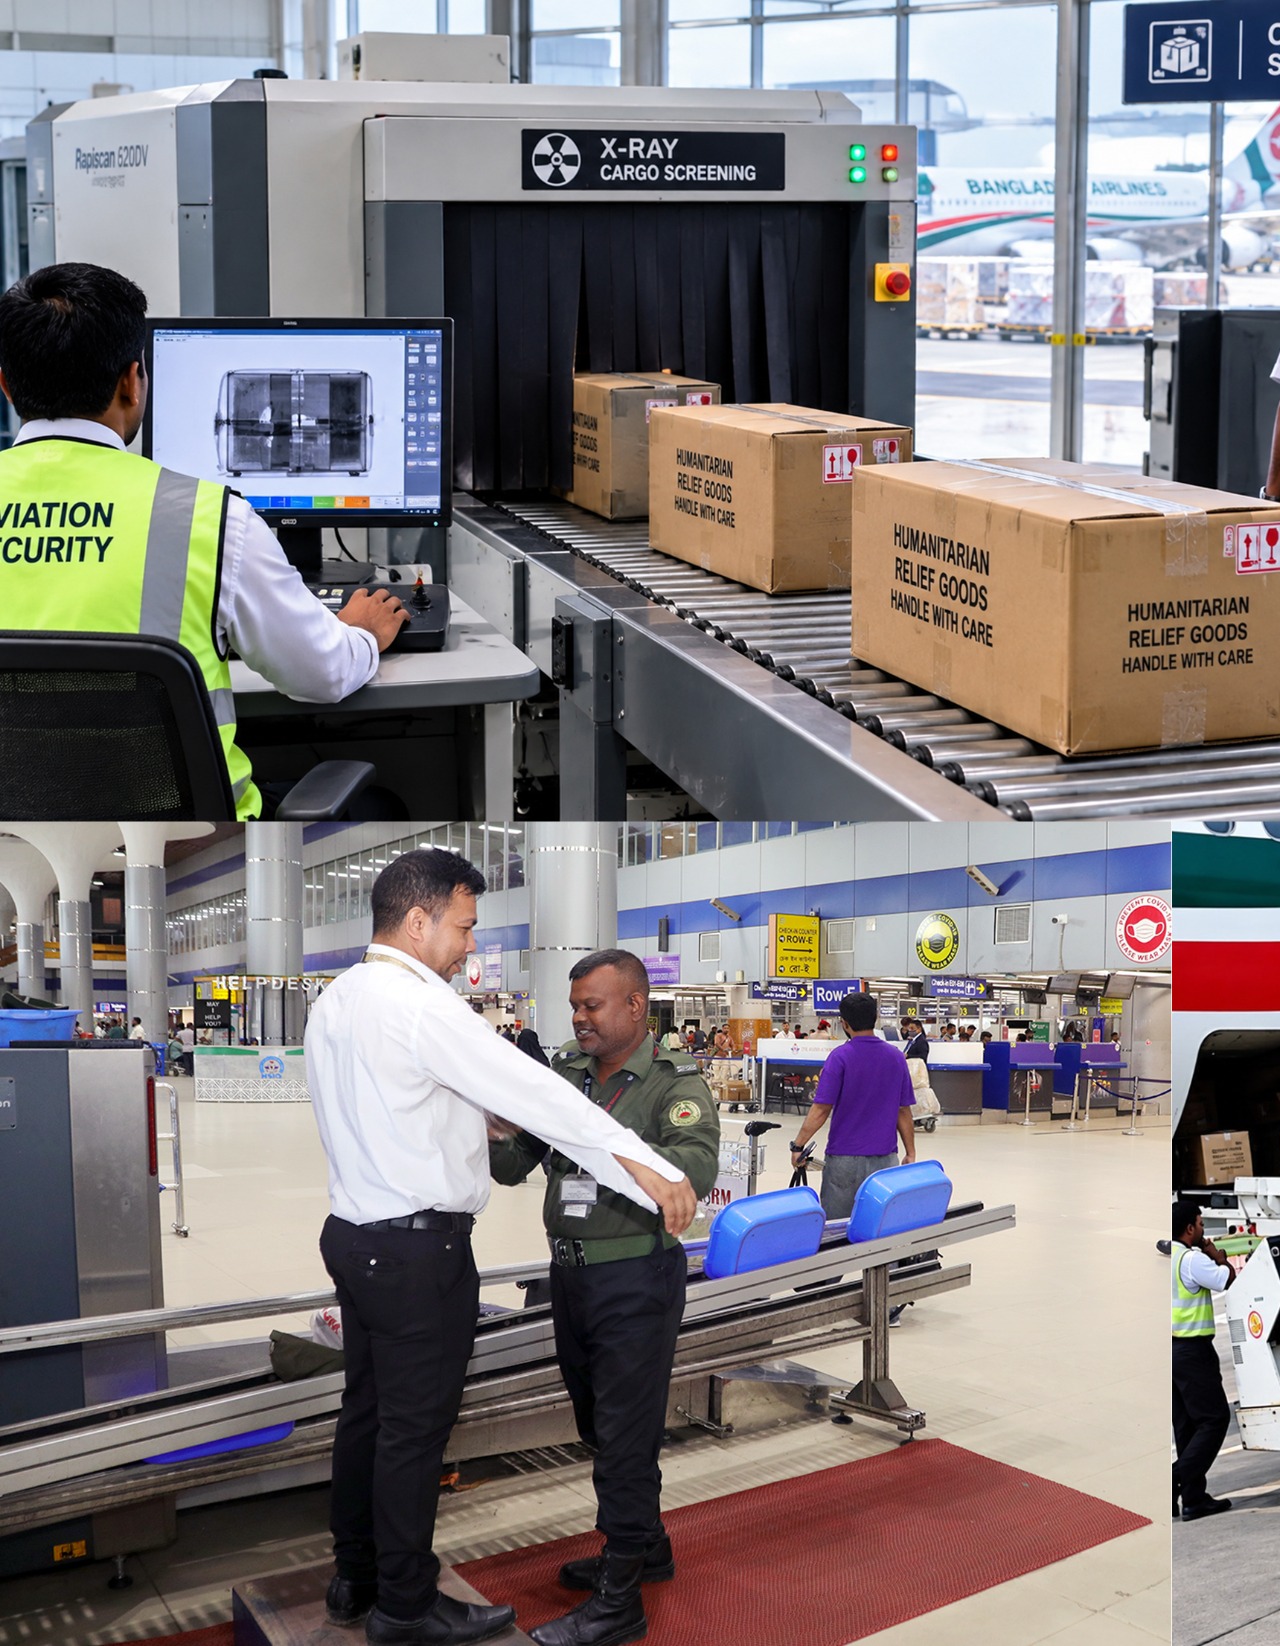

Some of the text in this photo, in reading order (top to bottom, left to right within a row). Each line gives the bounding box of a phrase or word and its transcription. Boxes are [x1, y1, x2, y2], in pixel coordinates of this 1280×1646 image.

[75, 144, 149, 174] Rapiscan 620DV
[600, 138, 678, 159] X-RAY
[600, 164, 756, 182] CARGO SCREENING
[1092, 181, 1167, 196] AIRLINES
[676, 448, 733, 479] HUMANITARIAN
[678, 471, 732, 503] RELIEF GOODS
[674, 496, 735, 528] HANDLE WITH CARE
[0, 536, 114, 563] CURITY
[894, 523, 990, 576] HUMANITARIAN
[895, 556, 988, 612] RELIEF GOODS
[891, 588, 993, 647] HANDLE WITH CARE
[1128, 596, 1249, 622] HUMANITARIAN
[1129, 623, 1247, 648] RELIEF GOODS
[1122, 648, 1253, 673] HANDLE WITH CARE
[1119, 898, 1144, 926] PREVENT
[786, 935, 813, 944] ROW-E
[1118, 934, 1137, 958] PLEASE
[1137, 952, 1159, 960] WEAR
[907, 1007, 916, 1016] 02
